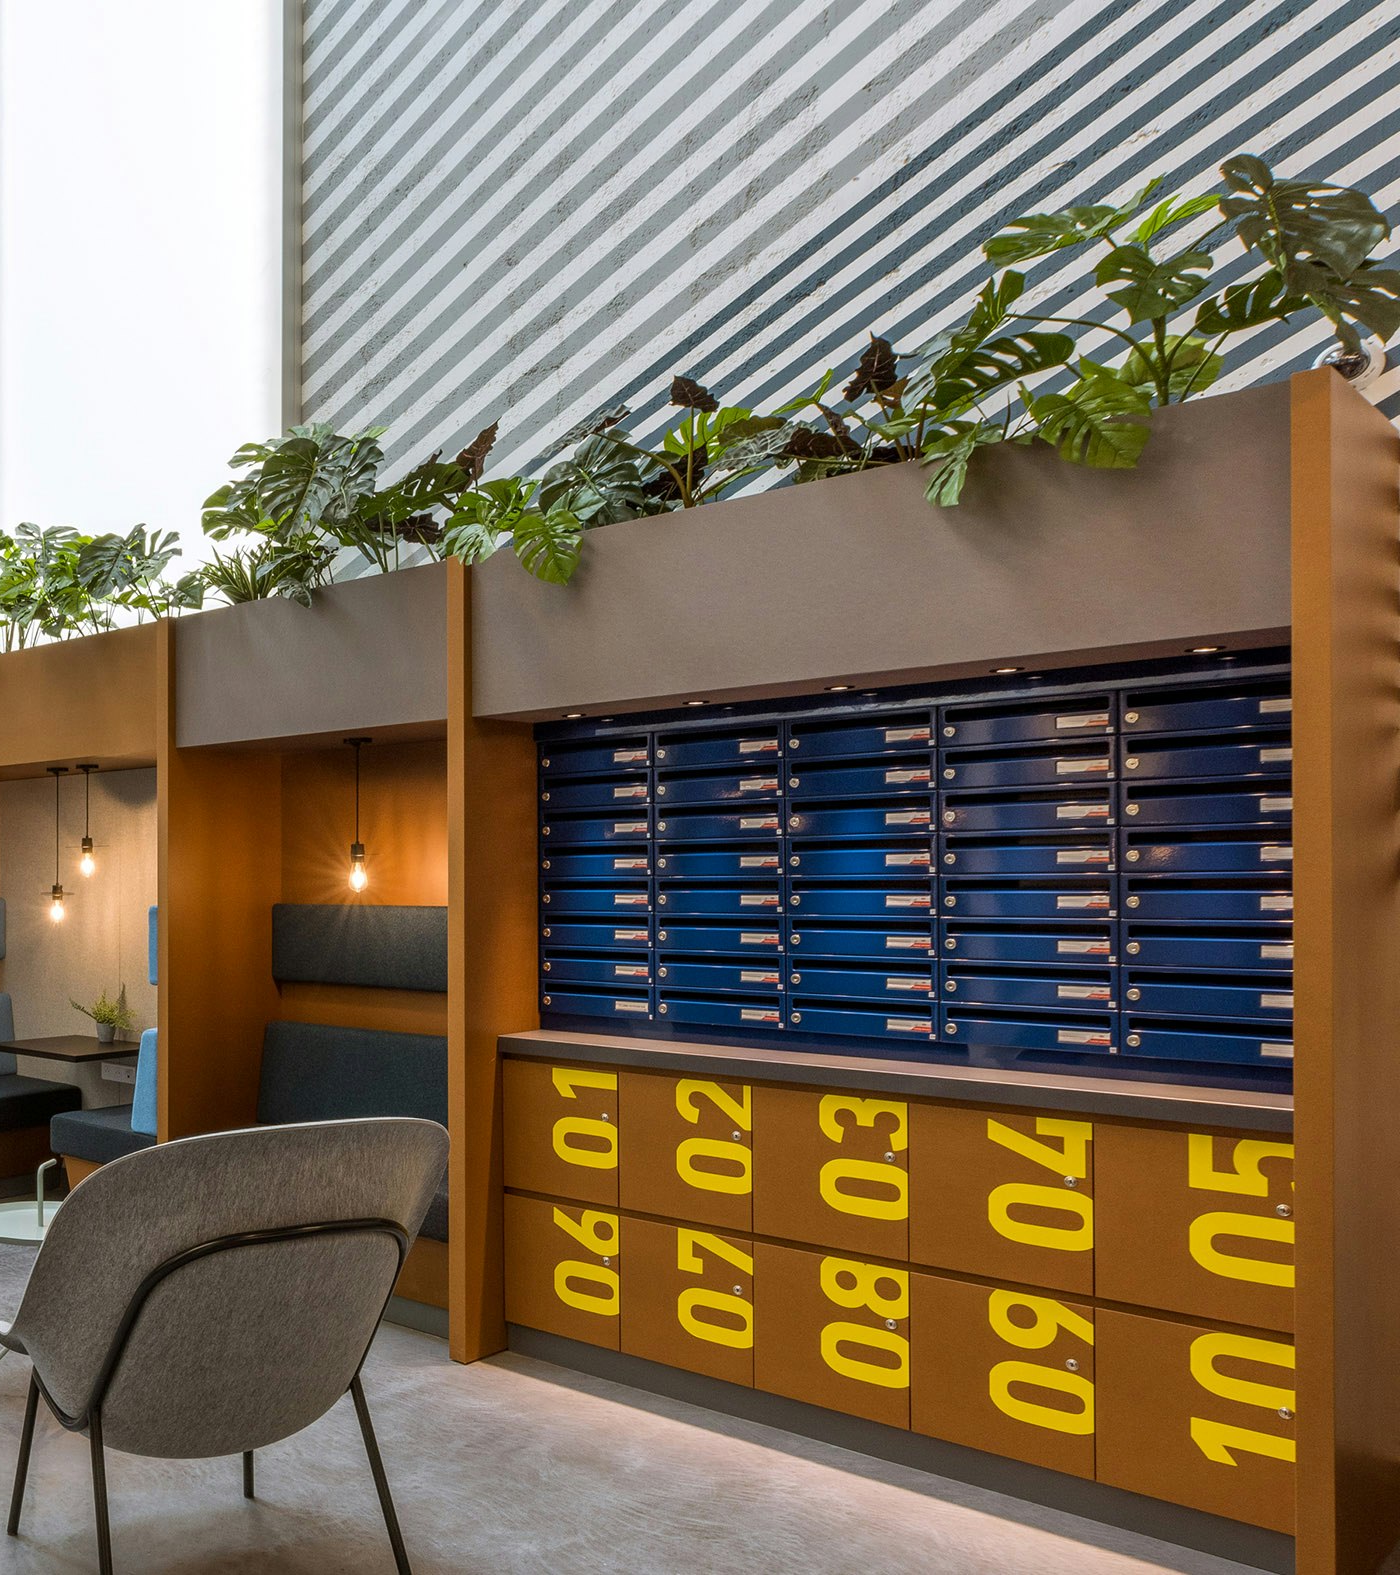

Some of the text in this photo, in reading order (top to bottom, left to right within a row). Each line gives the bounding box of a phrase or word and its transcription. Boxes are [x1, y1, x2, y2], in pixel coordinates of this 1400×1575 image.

[553, 1068, 617, 1169] 01
[676, 1078, 751, 1195] 02
[819, 1094, 907, 1221] 03
[987, 1118, 1093, 1252] 04
[1189, 1133, 1295, 1287] 05
[553, 1208, 619, 1316] 06
[677, 1229, 753, 1348] 07
[820, 1256, 909, 1389] 08
[989, 1288, 1094, 1435] 09
[1190, 1333, 1296, 1467] 10
